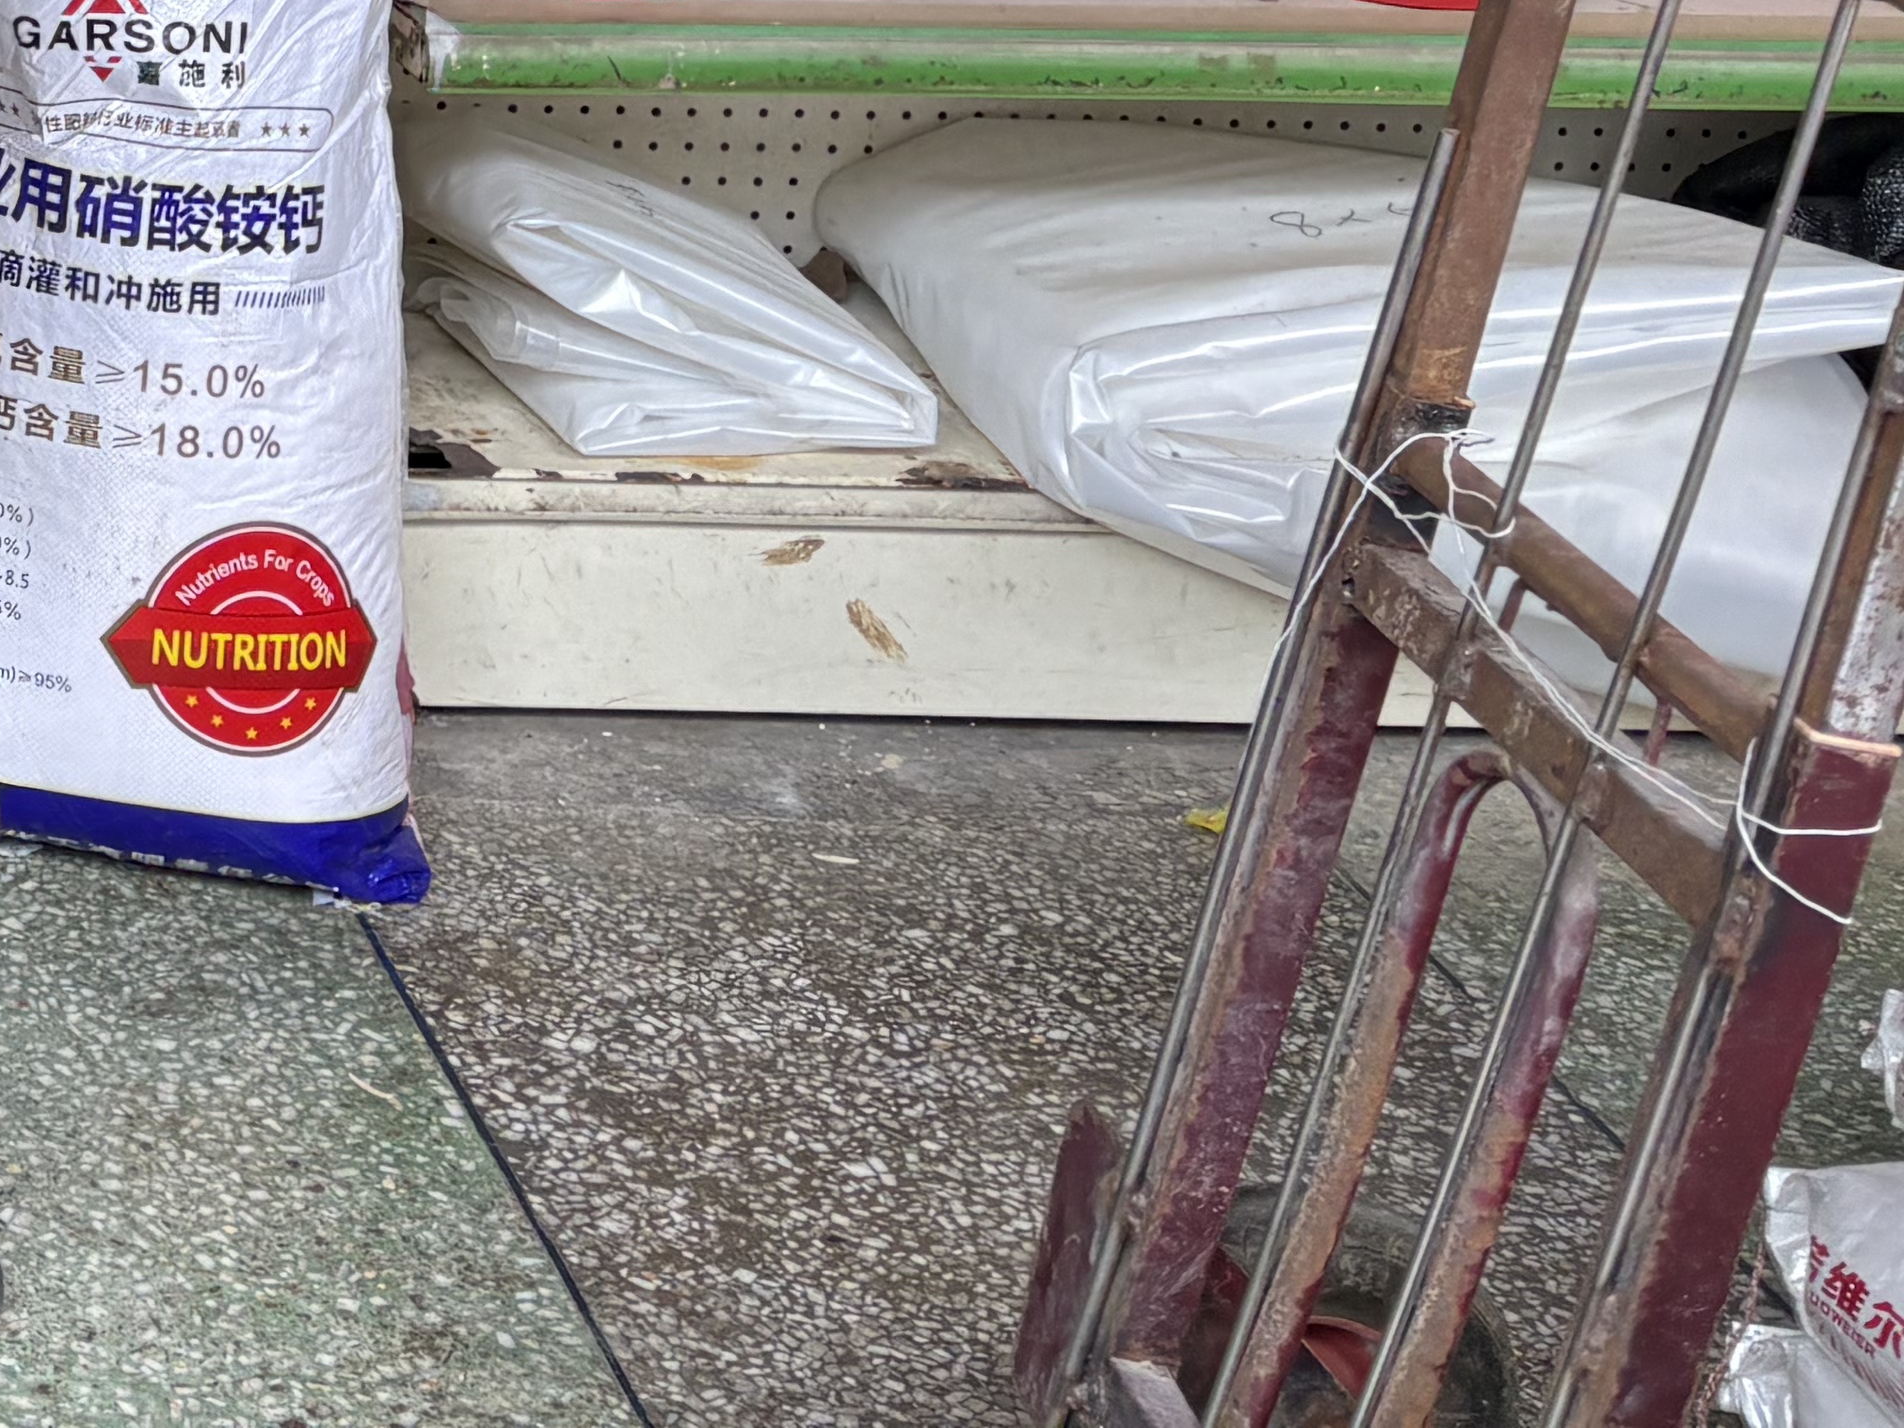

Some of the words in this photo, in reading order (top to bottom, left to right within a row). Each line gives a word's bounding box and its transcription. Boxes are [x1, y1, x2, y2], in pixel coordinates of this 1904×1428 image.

[13, 16, 248, 55] GARSONI
[138, 59, 246, 90] 嘉施利
[175, 551, 259, 606] Nutrients
[263, 548, 294, 573] For
[296, 559, 335, 607] Crops
[152, 628, 346, 671] NUTRITION
